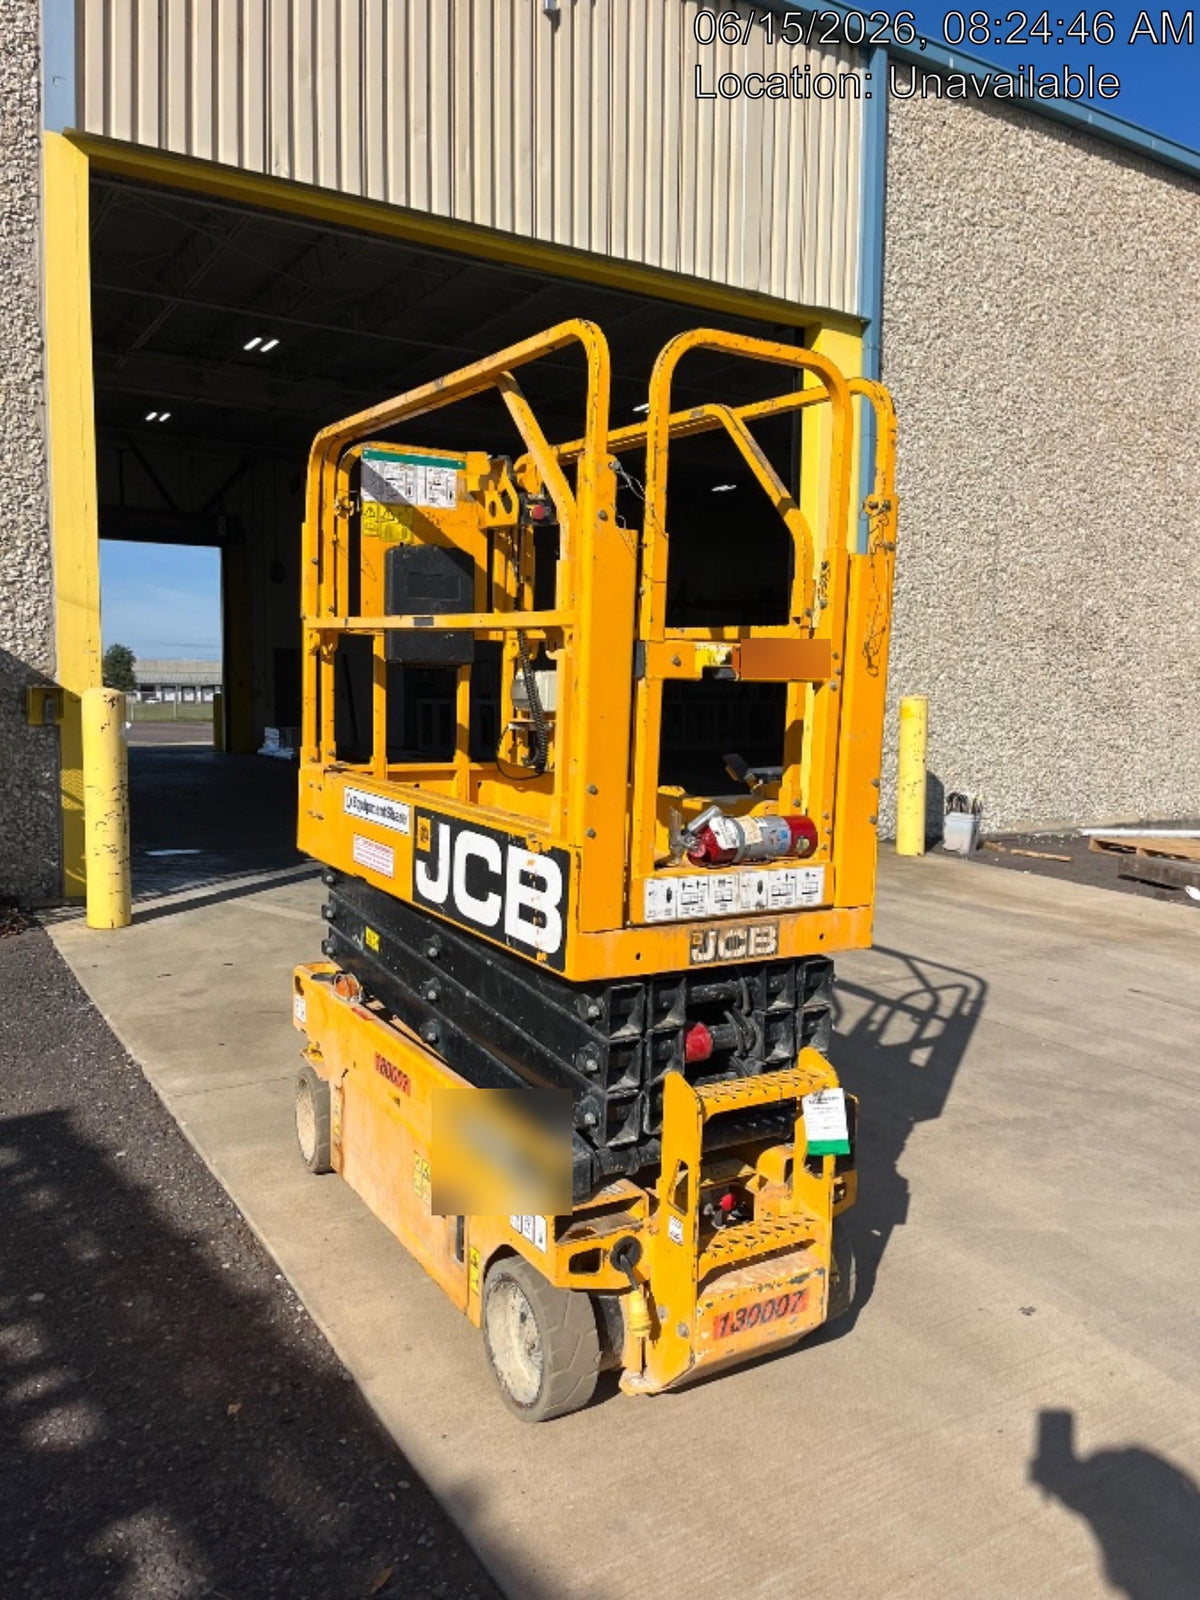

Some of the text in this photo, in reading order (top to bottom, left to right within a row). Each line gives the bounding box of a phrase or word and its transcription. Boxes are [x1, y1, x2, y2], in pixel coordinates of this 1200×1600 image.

[415, 822, 563, 954] JCB
[690, 925, 778, 962] JCB
[719, 1288, 807, 1338] 130007
